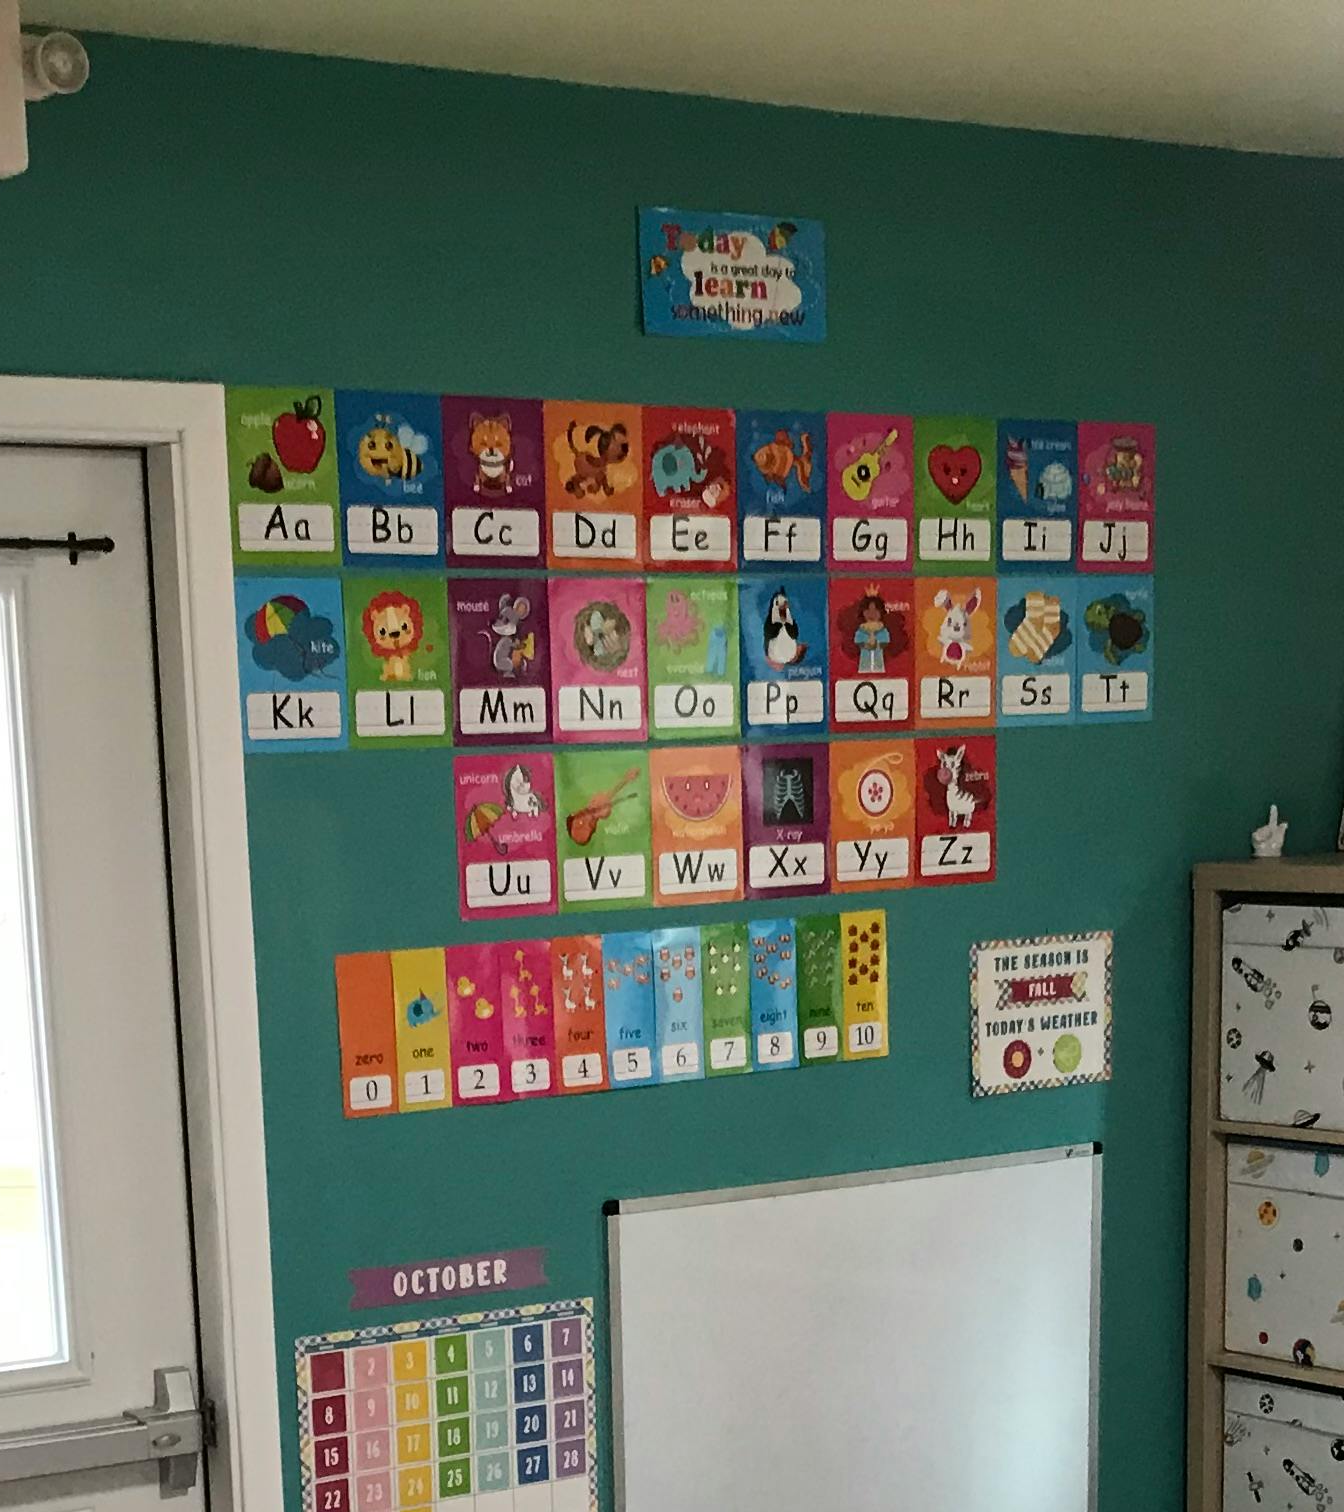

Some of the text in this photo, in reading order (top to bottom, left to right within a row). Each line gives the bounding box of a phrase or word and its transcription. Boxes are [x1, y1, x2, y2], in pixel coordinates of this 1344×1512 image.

[661, 224, 747, 260] Today
[694, 271, 768, 300] learn
[711, 263, 718, 273] is
[721, 265, 728, 274] a
[731, 266, 759, 277] great
[761, 267, 782, 281] day
[671, 302, 806, 327] something new
[265, 505, 311, 542] Aa
[373, 510, 413, 545] Bb
[474, 512, 513, 546] Cc
[575, 512, 617, 549] Dd
[672, 516, 709, 552] Ee
[765, 519, 797, 552] Ff
[938, 518, 974, 550] Hh
[1024, 522, 1047, 550] Ii
[852, 519, 887, 560] Gg
[1100, 523, 1127, 561] Jj
[457, 600, 489, 613] mouse
[311, 640, 334, 655] kite
[675, 685, 715, 718] Oo
[766, 682, 798, 723] Pp
[853, 681, 894, 719] Qq
[938, 678, 969, 708] Rr
[1021, 677, 1051, 705] Ss
[1099, 675, 1129, 703] Tt
[271, 695, 314, 729] Kk
[385, 693, 415, 726] Ll
[479, 690, 535, 724] Mm
[579, 687, 623, 720] Nn
[460, 773, 498, 785] unicorn
[965, 771, 989, 782] zebra
[499, 831, 543, 843] umbrella
[939, 836, 972, 865] Zz
[586, 856, 621, 890] Vv
[673, 852, 724, 884] Ww
[769, 847, 806, 877] Xx
[854, 841, 888, 877] Yy
[489, 864, 530, 896] Uu
[994, 949, 1088, 972] THE SEASON IS
[1029, 982, 1056, 997] FALL
[760, 1010, 787, 1025] eight
[809, 1007, 830, 1017] nine
[857, 1001, 874, 1012] ten
[1041, 1011, 1098, 1030] WEATHER
[568, 1029, 594, 1041] four
[619, 1026, 642, 1040] five
[672, 1021, 687, 1032] six
[712, 1016, 742, 1029] seven
[857, 1026, 874, 1045] 10
[413, 1048, 434, 1058] one
[467, 1042, 488, 1052] two
[513, 1034, 545, 1046] three
[724, 1042, 734, 1061] 7
[770, 1036, 780, 1056] 8
[817, 1032, 826, 1049] 9
[356, 1054, 383, 1066] zero
[578, 1058, 588, 1078] 4
[627, 1052, 638, 1072] 5
[676, 1047, 686, 1067] 6
[423, 1075, 429, 1095] 1
[474, 1069, 485, 1090] 2
[526, 1064, 536, 1084] 3
[366, 1080, 377, 1101] 0
[393, 1259, 507, 1297] OCTOBER
[368, 1328, 569, 1375] 2 3 4 5 6 7
[325, 1370, 574, 1424] 8 9 10 11 12 13 14
[325, 1410, 576, 1466] 15 16 17 18 19 20 21
[325, 1450, 578, 1509] 22 23 24 25 26 27 28
